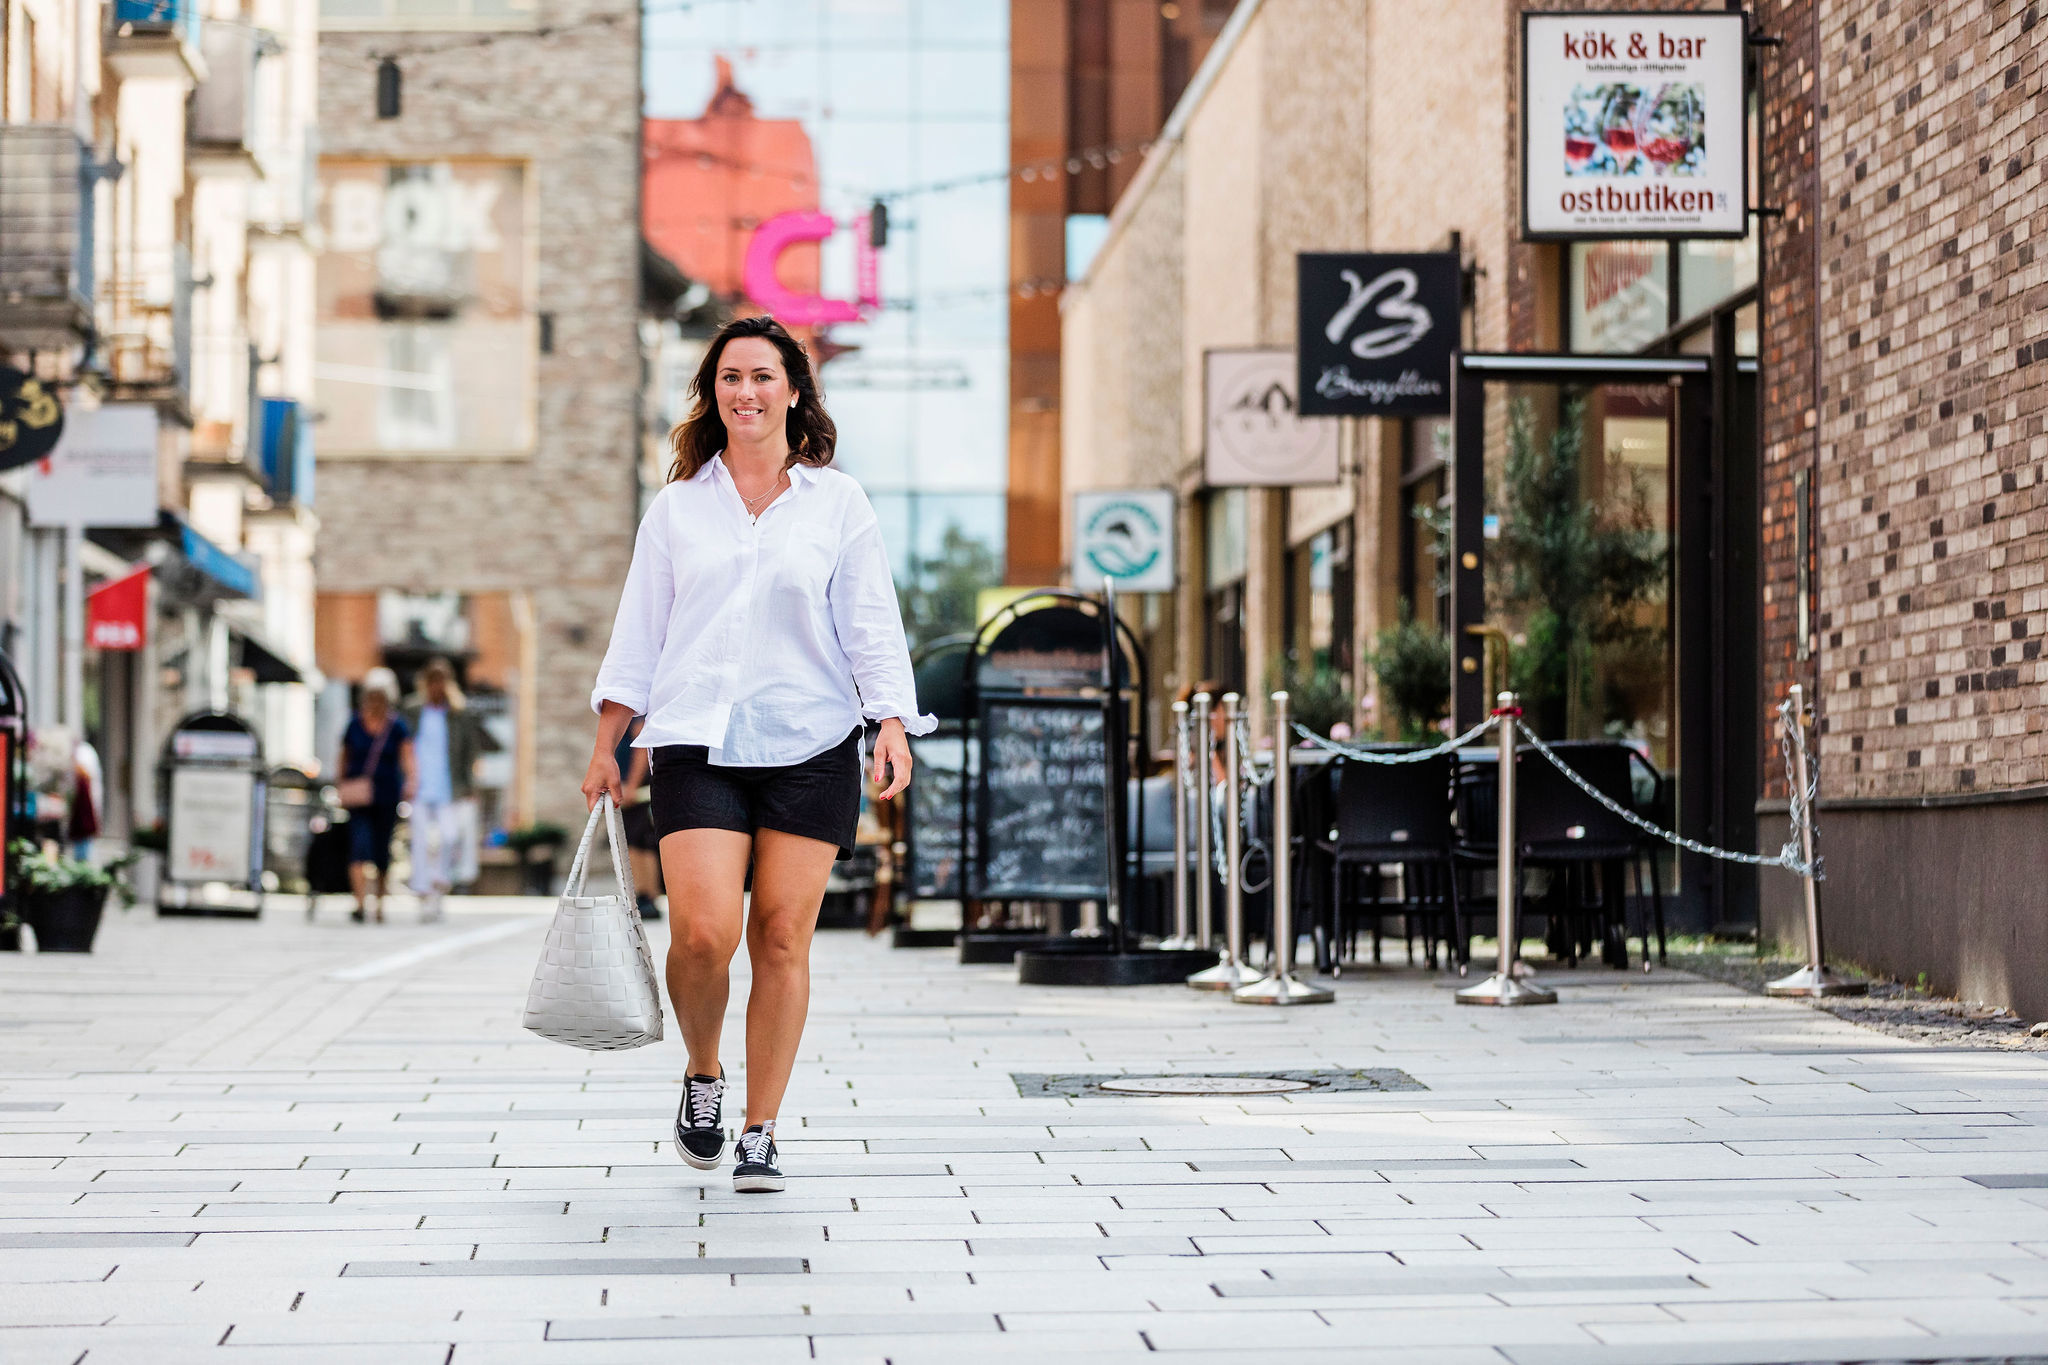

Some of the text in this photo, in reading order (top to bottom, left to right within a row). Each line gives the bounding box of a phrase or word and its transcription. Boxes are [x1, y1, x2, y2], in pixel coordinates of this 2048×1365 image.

[1563, 32, 1707, 60] kök & bar
[1561, 185, 1714, 213] ostbutiken
